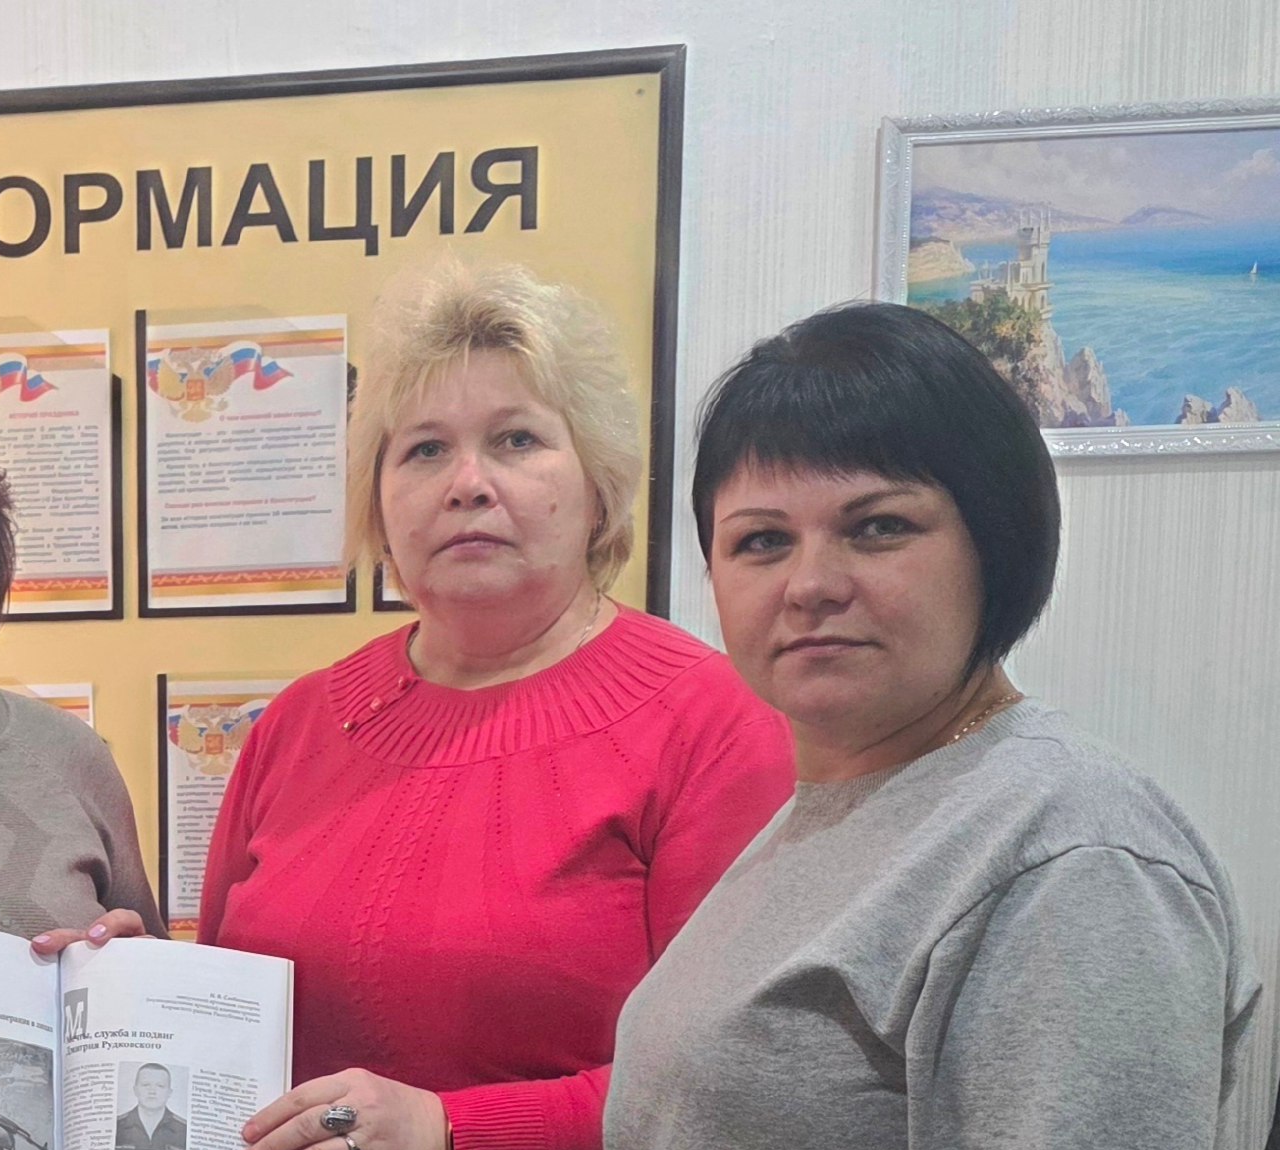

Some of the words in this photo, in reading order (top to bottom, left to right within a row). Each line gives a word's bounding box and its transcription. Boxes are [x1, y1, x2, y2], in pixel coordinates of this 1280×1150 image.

[94, 1028, 129, 1040] служба
[139, 1031, 175, 1040] подвиг
[101, 1040, 162, 1052] Рудковского
